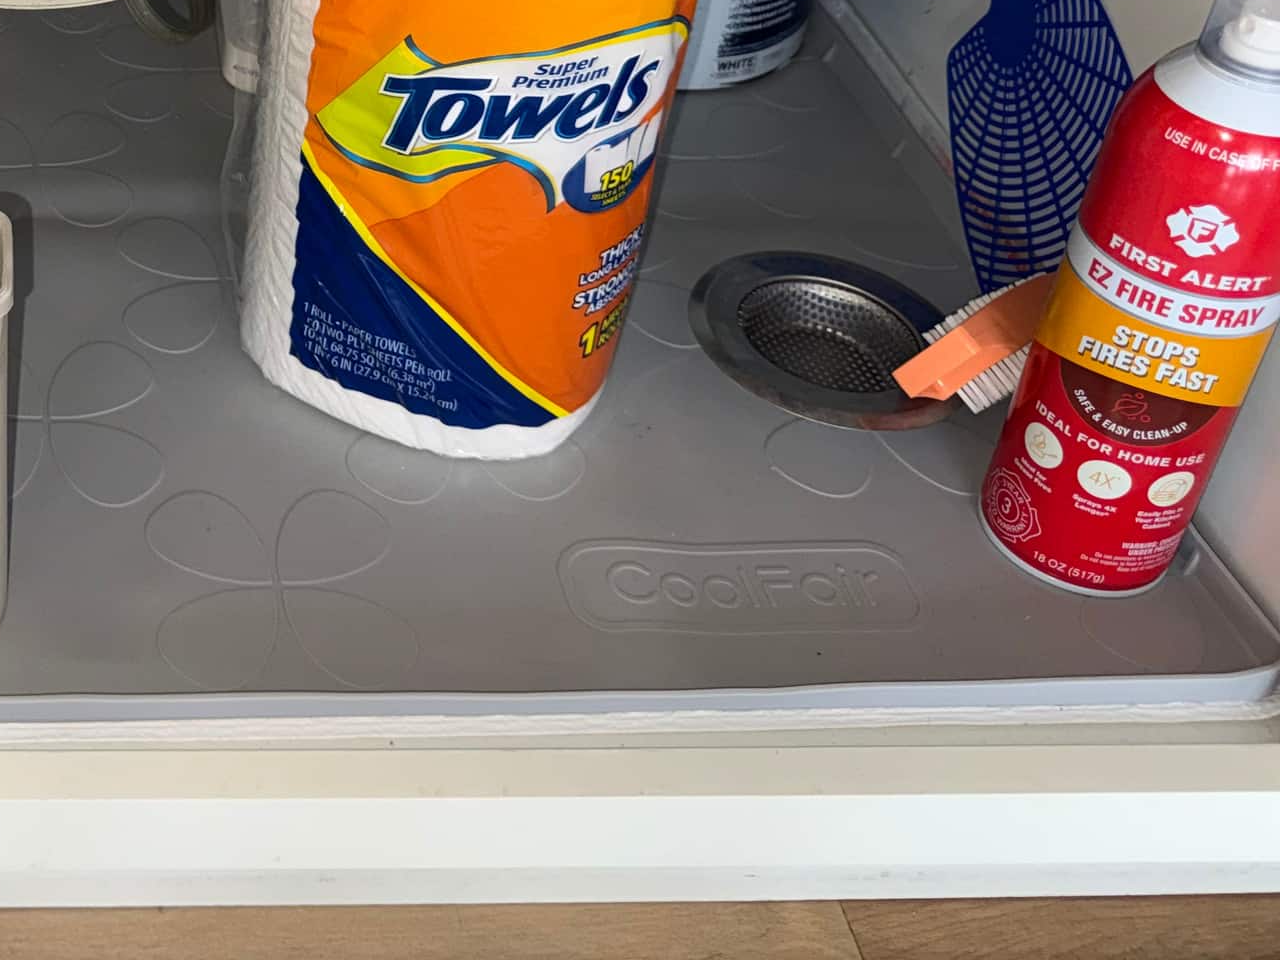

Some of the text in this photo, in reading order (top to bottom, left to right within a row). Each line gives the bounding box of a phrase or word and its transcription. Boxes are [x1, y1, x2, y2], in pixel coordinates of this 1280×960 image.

[512, 66, 608, 88] Premium
[534, 56, 598, 77] Super
[717, 59, 753, 71] WHITE
[382, 52, 661, 154] Towels
[1164, 127, 1192, 150] USE
[1191, 140, 1207, 156] IN
[1208, 147, 1247, 170] CASE
[600, 160, 634, 191] 150
[1110, 233, 1265, 292] FIRST ALERT
[1088, 257, 1265, 329] EZ FIRE SPRAY
[311, 304, 334, 326] ROLL
[374, 335, 417, 358] TOWELS
[1112, 325, 1200, 367] STOPS
[330, 341, 359, 361] 68.75
[360, 352, 376, 367] SQ
[387, 366, 415, 384] (6.38
[404, 358, 425, 376] PER
[426, 366, 453, 382] ROLL
[1077, 335, 1219, 394] FIRES FAST
[340, 357, 352, 372] IN
[353, 362, 381, 381] (27.9
[435, 397, 459, 412] cm)
[1035, 400, 1207, 468] IDEAL FOR HOME USE
[1074, 388, 1189, 441] SAFE & EASY CLEAN-UP
[1072, 493, 1102, 509] Sprays
[1089, 471, 1114, 491] 4X
[1001, 497, 1012, 514] 3
[1033, 550, 1105, 584] 18 OZ (517g)
